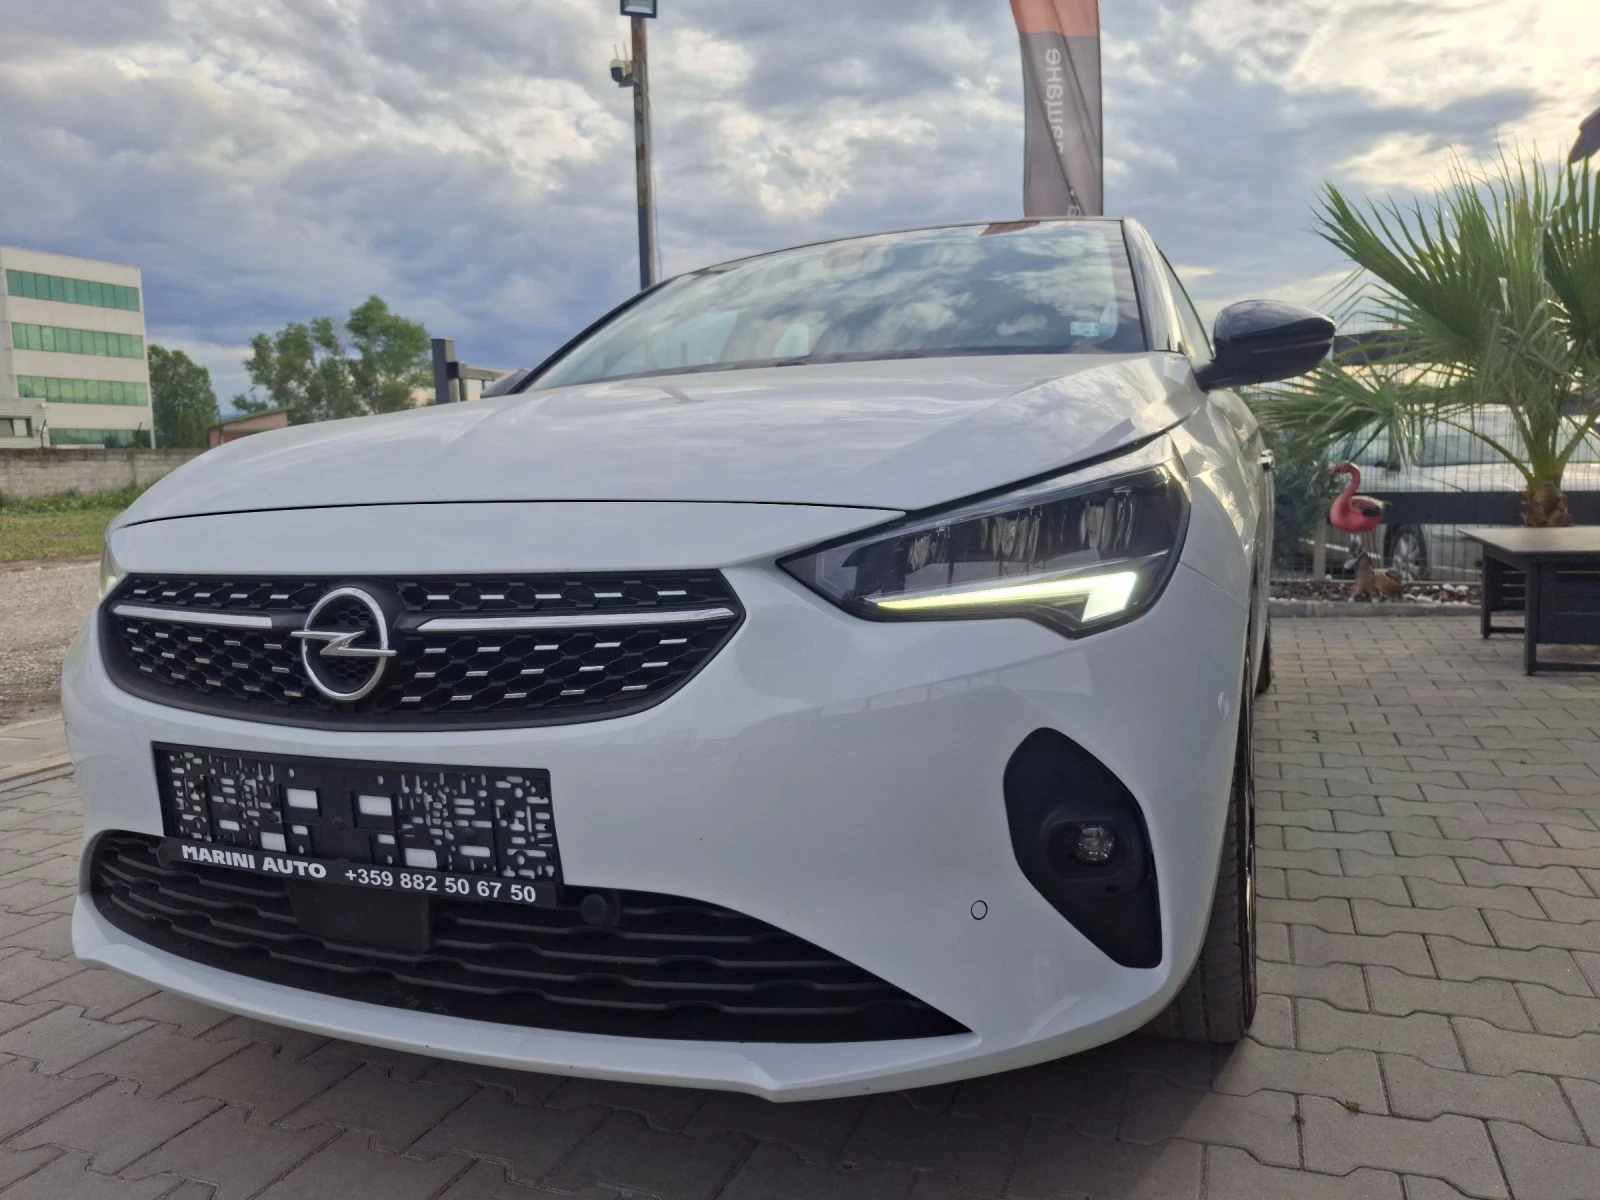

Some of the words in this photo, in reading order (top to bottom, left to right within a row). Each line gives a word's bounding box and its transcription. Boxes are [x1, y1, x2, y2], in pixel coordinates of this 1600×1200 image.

[181, 844, 256, 869] MARINI
[262, 856, 327, 879] AUTO
[345, 868, 394, 887] +359
[399, 873, 438, 891] 882
[445, 877, 470, 895] 50
[476, 880, 502, 898] 67
[510, 884, 537, 903] 50
